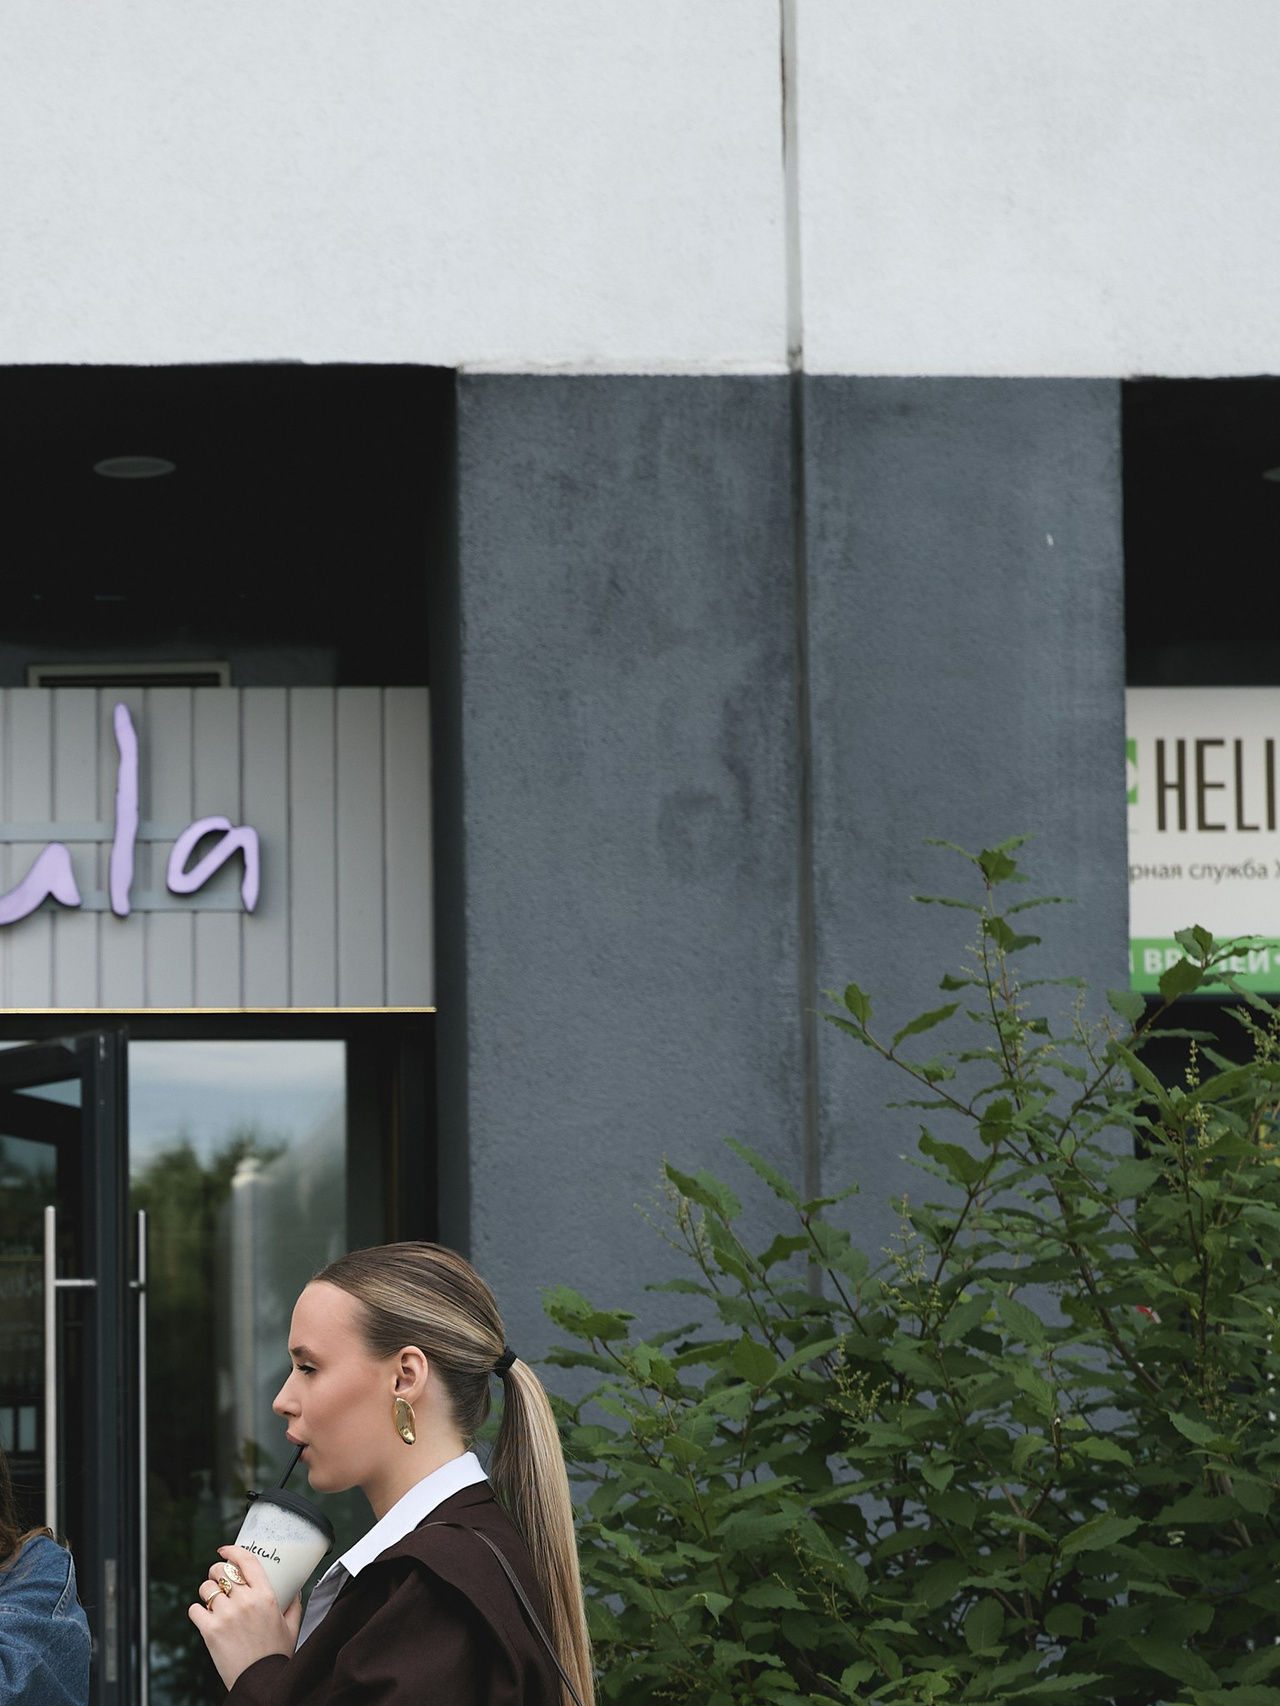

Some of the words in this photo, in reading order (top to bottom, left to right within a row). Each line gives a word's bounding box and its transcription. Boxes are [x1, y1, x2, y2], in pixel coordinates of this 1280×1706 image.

[1156, 738, 1276, 832] HELI
[1188, 857, 1268, 884] служба
[1143, 943, 1270, 975] ВРЕЙ
